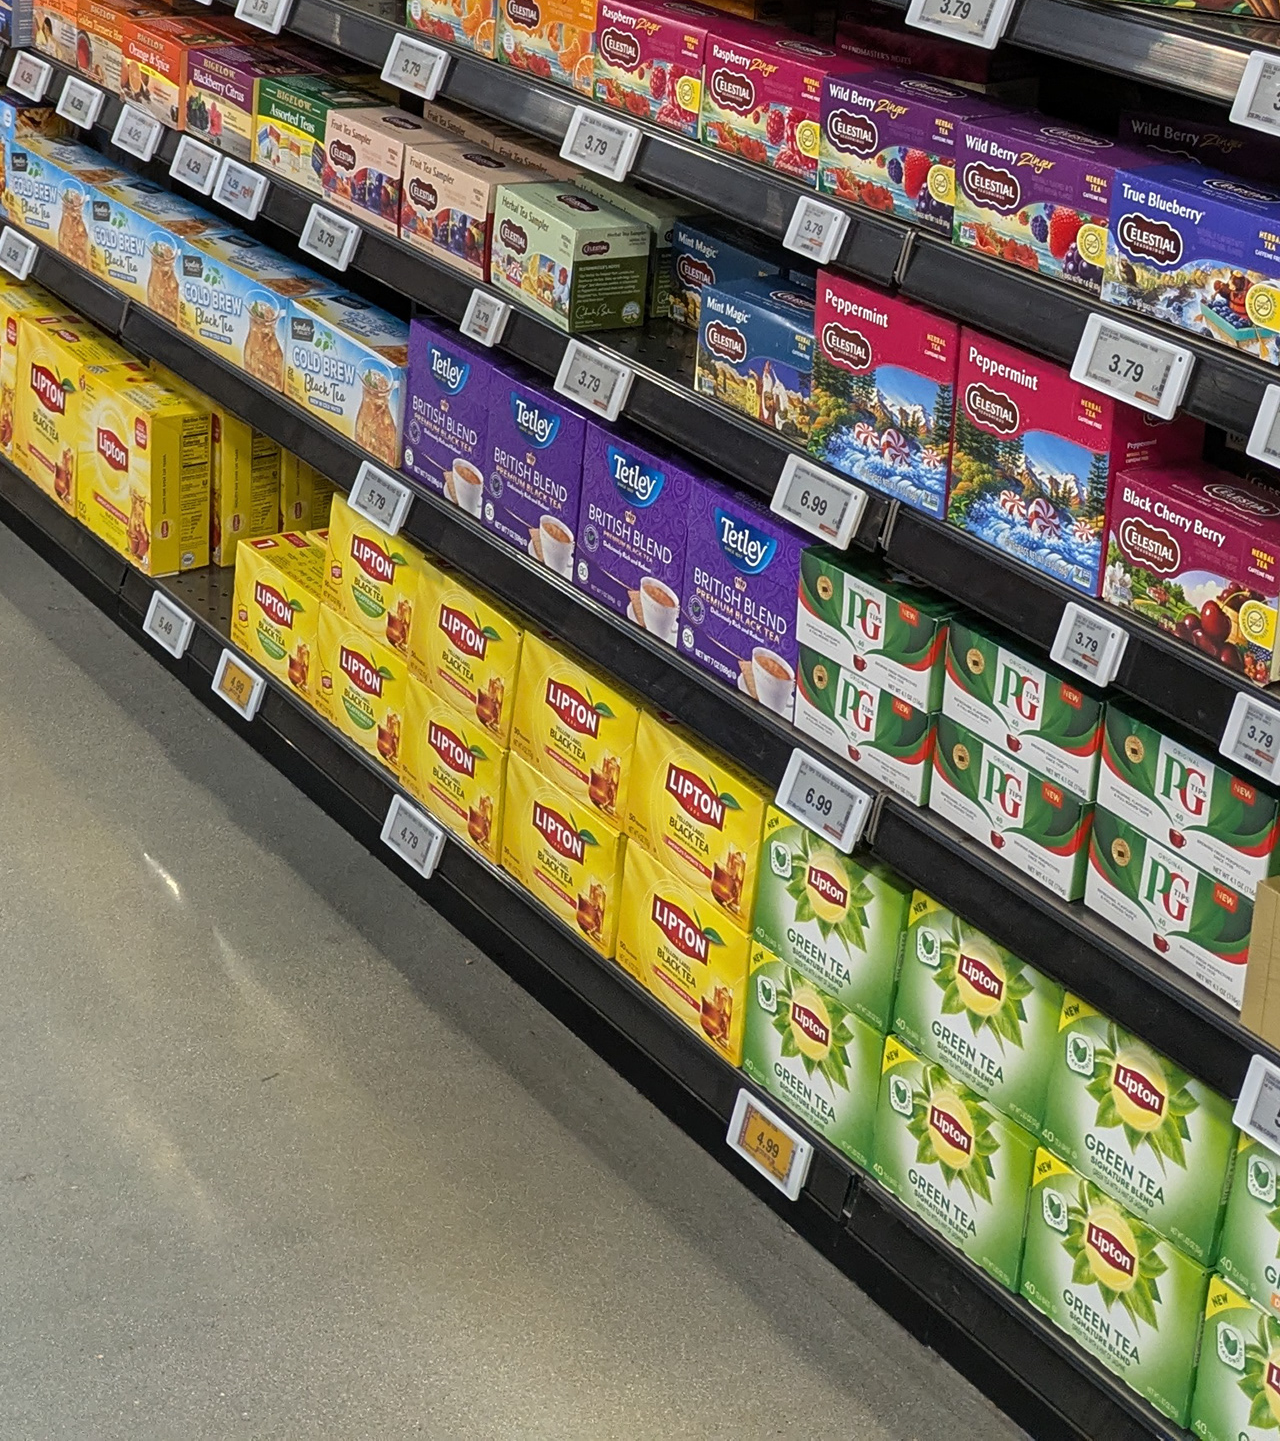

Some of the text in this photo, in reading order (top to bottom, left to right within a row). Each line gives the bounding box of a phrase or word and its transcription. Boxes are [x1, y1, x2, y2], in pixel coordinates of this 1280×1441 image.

[270, 104, 315, 133] Assorted Teas
[276, 90, 312, 111] BIGELOW
[1122, 182, 1202, 226] True Blueberry
[292, 346, 356, 385] COLD BREW
[969, 346, 1038, 392] Peppermint
[613, 453, 656, 500] Tetley
[589, 503, 672, 567] BRITISH BLEND
[441, 607, 486, 656] LIPTON
[1116, 1067, 1165, 1112] Lipton
[1083, 1132, 1170, 1206] GREEN TEA
